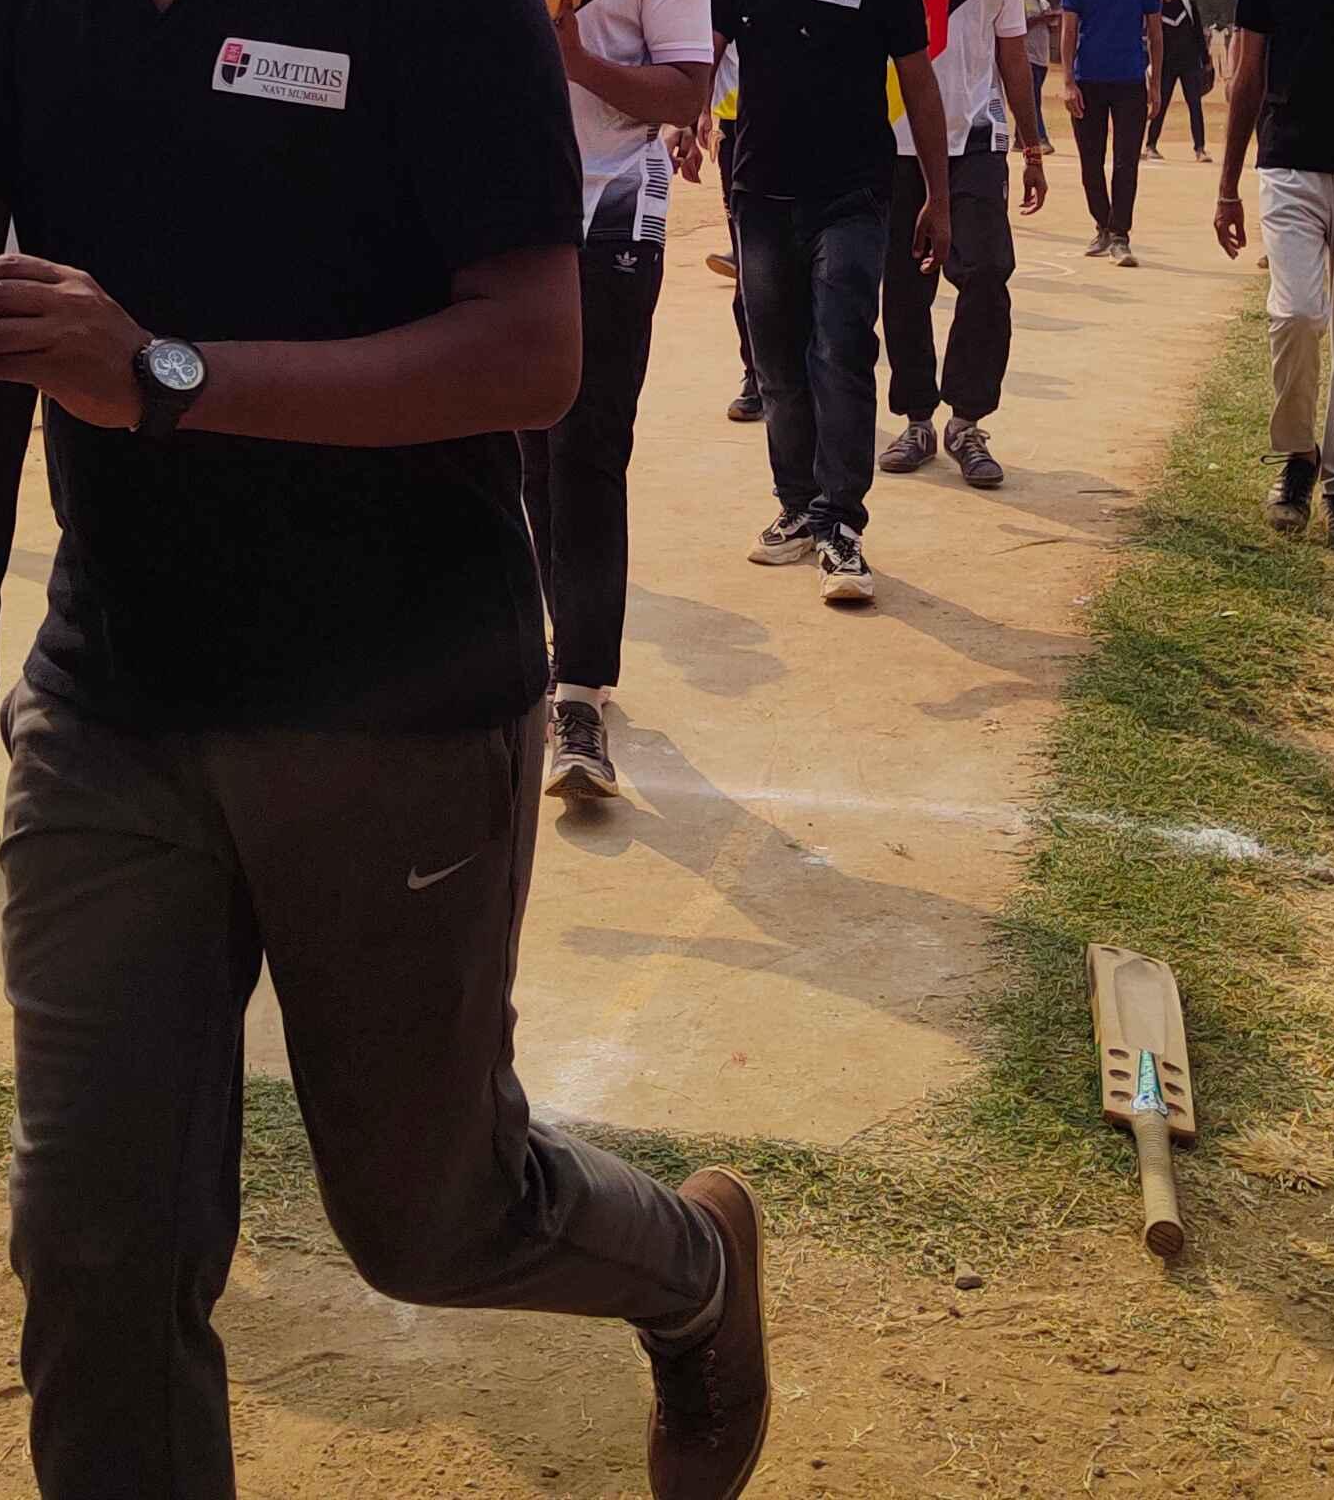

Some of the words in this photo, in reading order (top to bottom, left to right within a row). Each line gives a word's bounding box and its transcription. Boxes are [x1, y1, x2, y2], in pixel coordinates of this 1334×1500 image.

[255, 58, 343, 88] DMTIMS
[261, 85, 286, 97] NAVI
[287, 88, 328, 102] MUMBAI
